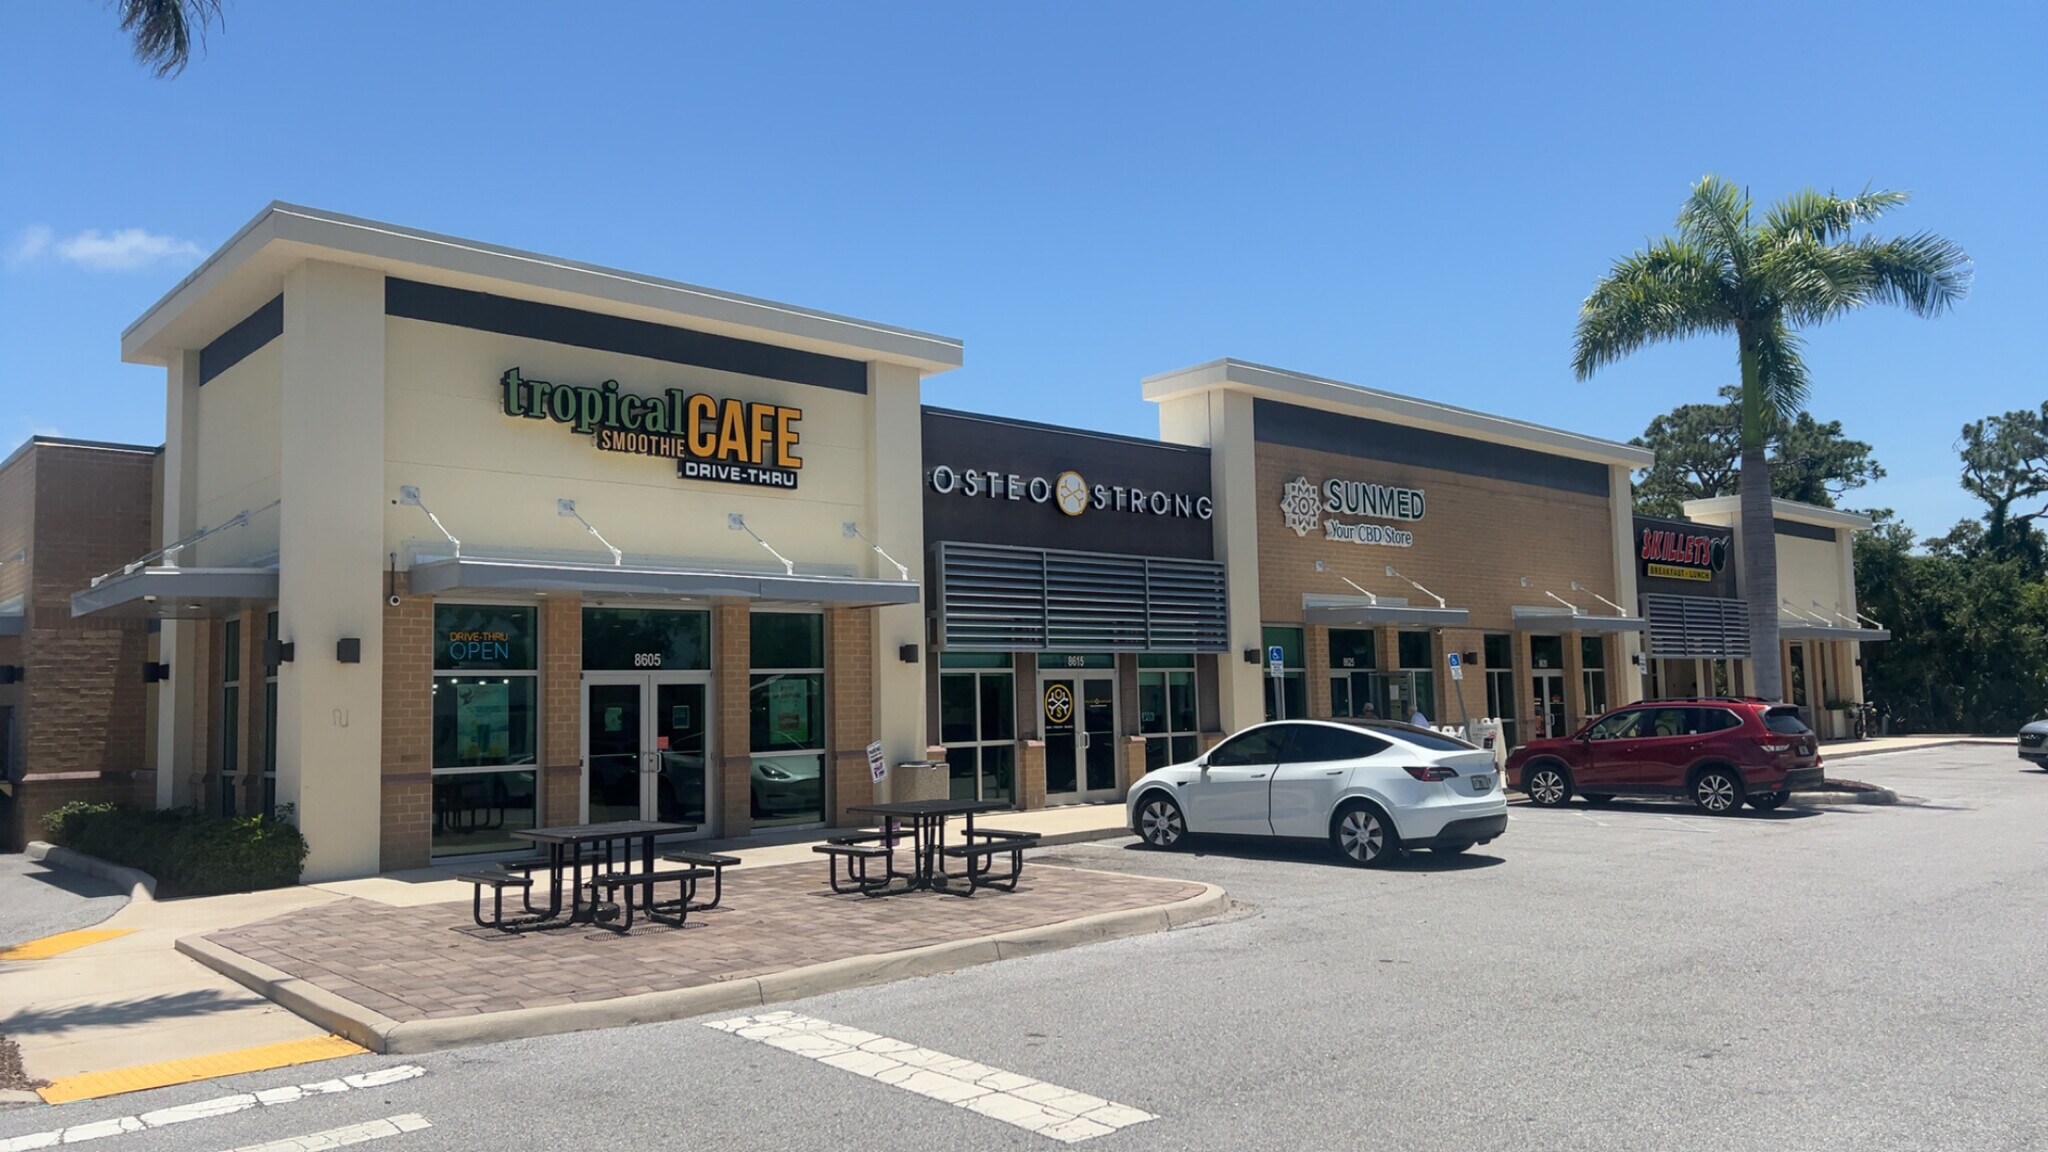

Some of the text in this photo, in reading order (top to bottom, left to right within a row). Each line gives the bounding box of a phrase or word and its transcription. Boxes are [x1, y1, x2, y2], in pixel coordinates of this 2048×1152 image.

[502, 367, 685, 435] tropical
[601, 429, 686, 459] SMOOTHIE
[687, 393, 803, 469] CAFE
[685, 461, 795, 487] DRIVE-THRU
[931, 465, 1213, 520] OSTEO STRONG
[1327, 480, 1426, 520] SUNMED
[1330, 520, 1412, 546] Your CBD Store
[1649, 565, 1710, 580] BREAKFAST LUNCH
[450, 631, 509, 642] DRIVE-THRU
[450, 641, 509, 660] OPEN
[634, 653, 661, 667] 8605
[1067, 655, 1085, 667] 8615
